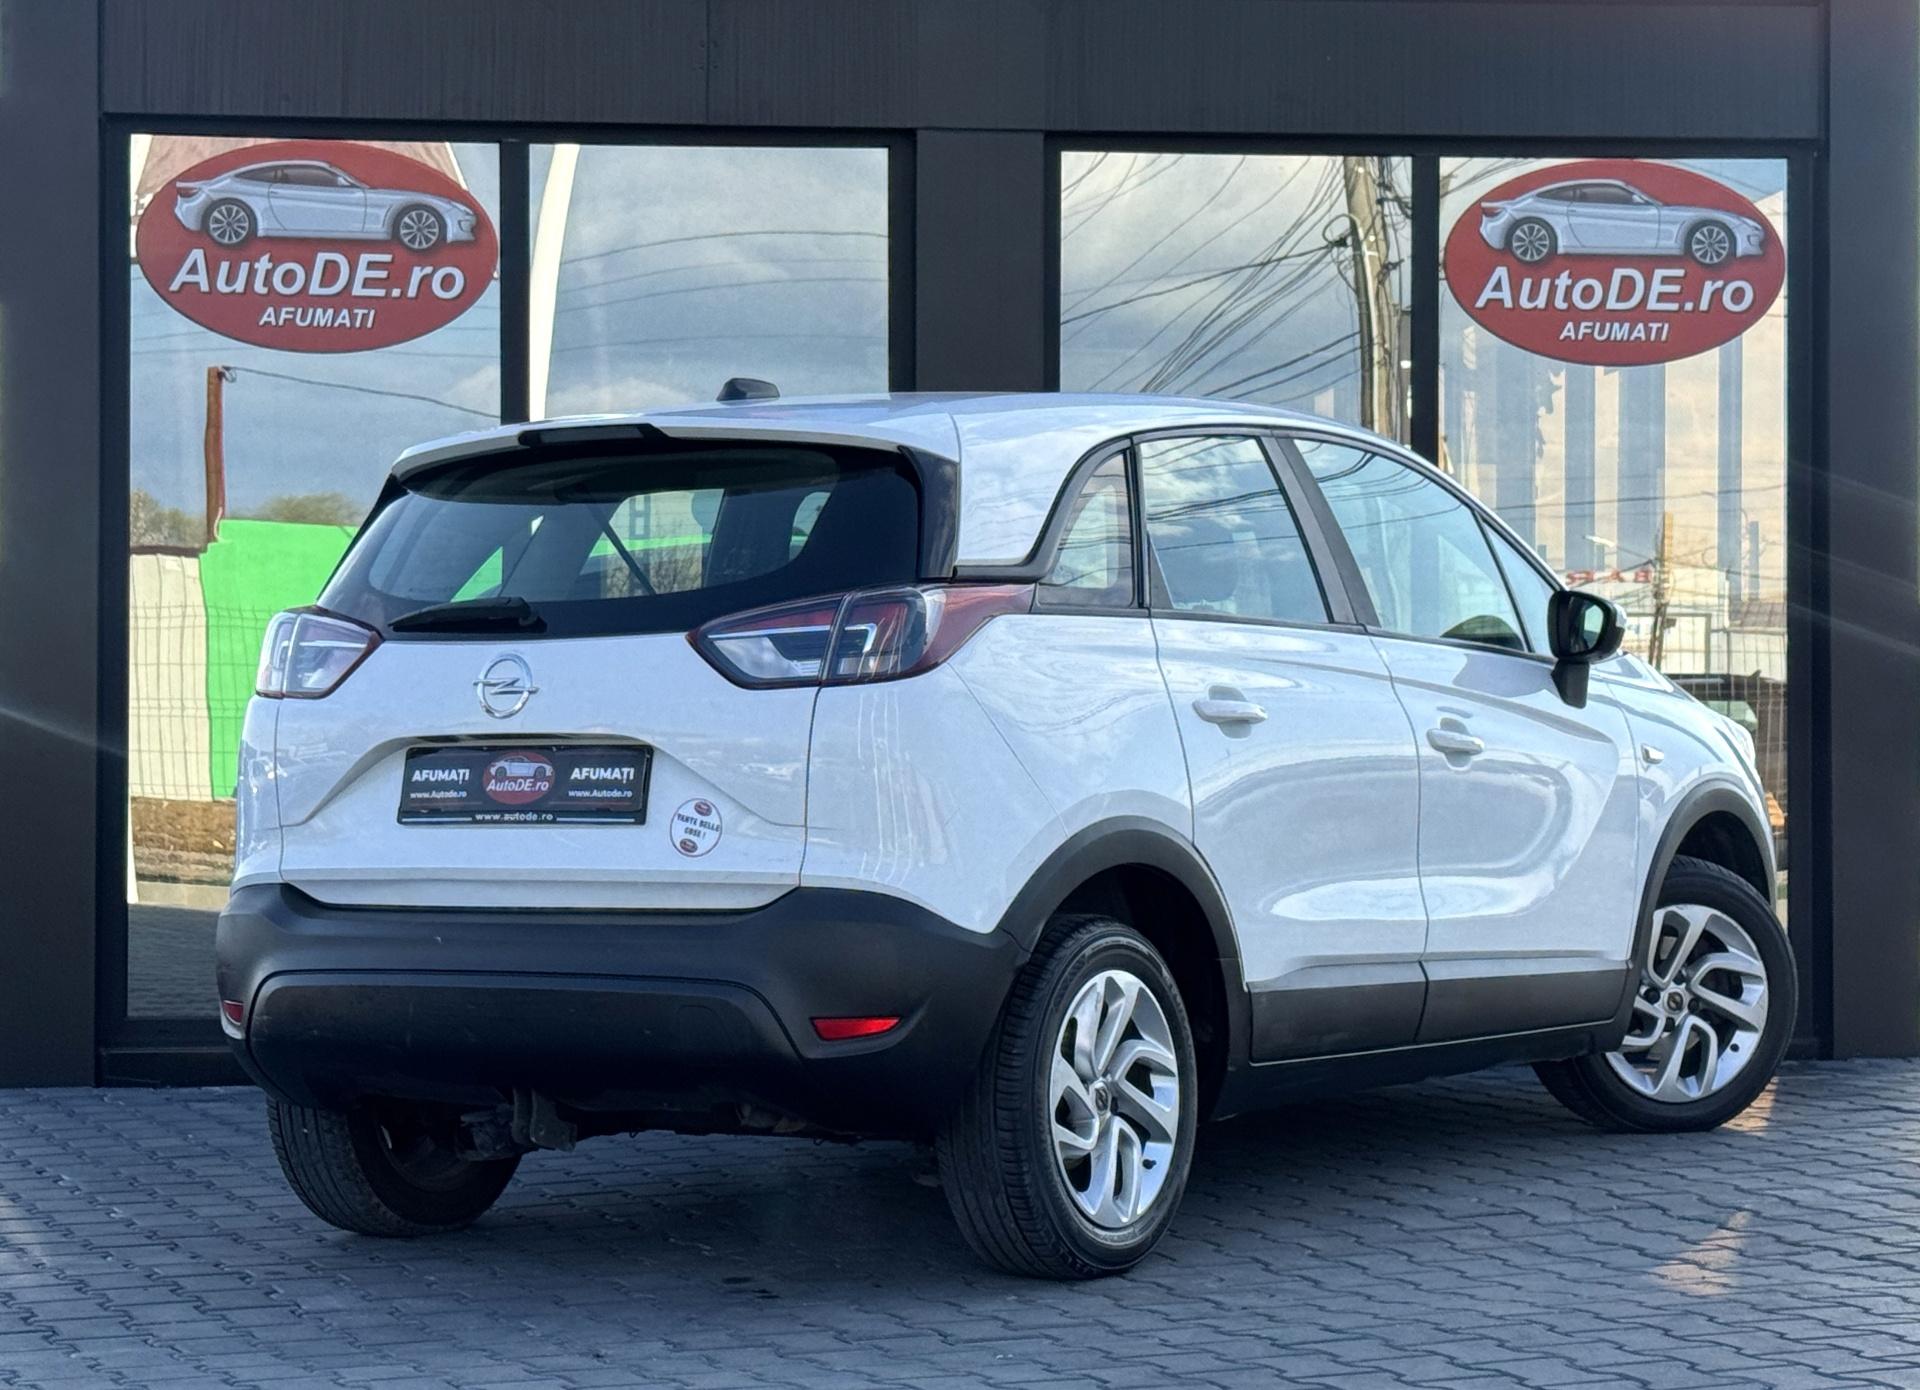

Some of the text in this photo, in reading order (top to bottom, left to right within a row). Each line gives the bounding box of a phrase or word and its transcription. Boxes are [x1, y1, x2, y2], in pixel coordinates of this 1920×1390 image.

[168, 248, 466, 301] AutoDE.ro
[1474, 266, 1755, 314] AutoDE.ro
[258, 306, 377, 330] AFUMATI
[1559, 321, 1670, 343] AFUMATI
[486, 778, 549, 792] AutoDE.ro
[568, 789, 633, 799] www.Autode.ro
[410, 790, 467, 799] www.Autode.ro
[475, 811, 554, 822] www.autode.ro
